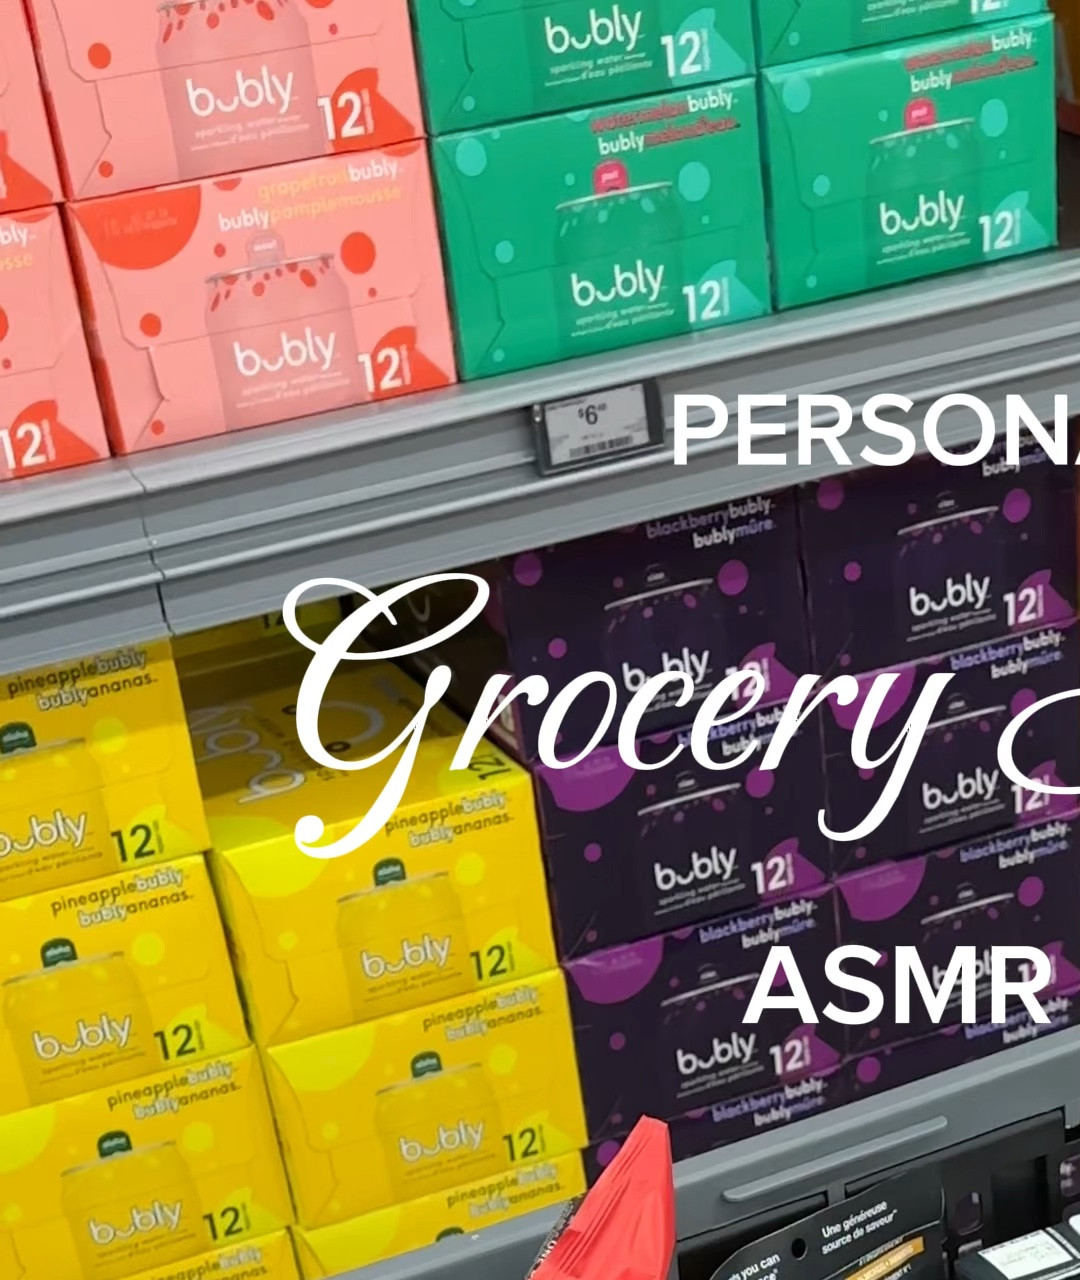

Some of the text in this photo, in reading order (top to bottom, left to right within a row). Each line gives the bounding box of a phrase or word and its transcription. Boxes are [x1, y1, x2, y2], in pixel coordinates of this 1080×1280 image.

[545, 4, 642, 54] bubly
[661, 30, 702, 78] 12
[186, 64, 294, 117] bubly
[317, 91, 364, 140] 12
[880, 190, 964, 235] bubly
[979, 211, 1013, 252] 12
[571, 259, 664, 309] bubly
[682, 279, 723, 324] 12
[233, 326, 336, 376] bubly
[358, 348, 402, 393] 12
[909, 571, 992, 618] bubly
[922, 766, 999, 810] bubly
[110, 823, 155, 865] 12
[654, 844, 737, 893] bubly
[361, 933, 454, 980] bubly
[469, 944, 508, 982] 12
[32, 1013, 133, 1062] bubly
[153, 1022, 197, 1062] 12
[677, 1031, 758, 1077] bubly
[399, 1119, 486, 1164] bubly
[502, 1127, 539, 1162] 12
[89, 1198, 183, 1246] bubly
[202, 1206, 242, 1242] 12
[822, 1222, 841, 1238] Une
